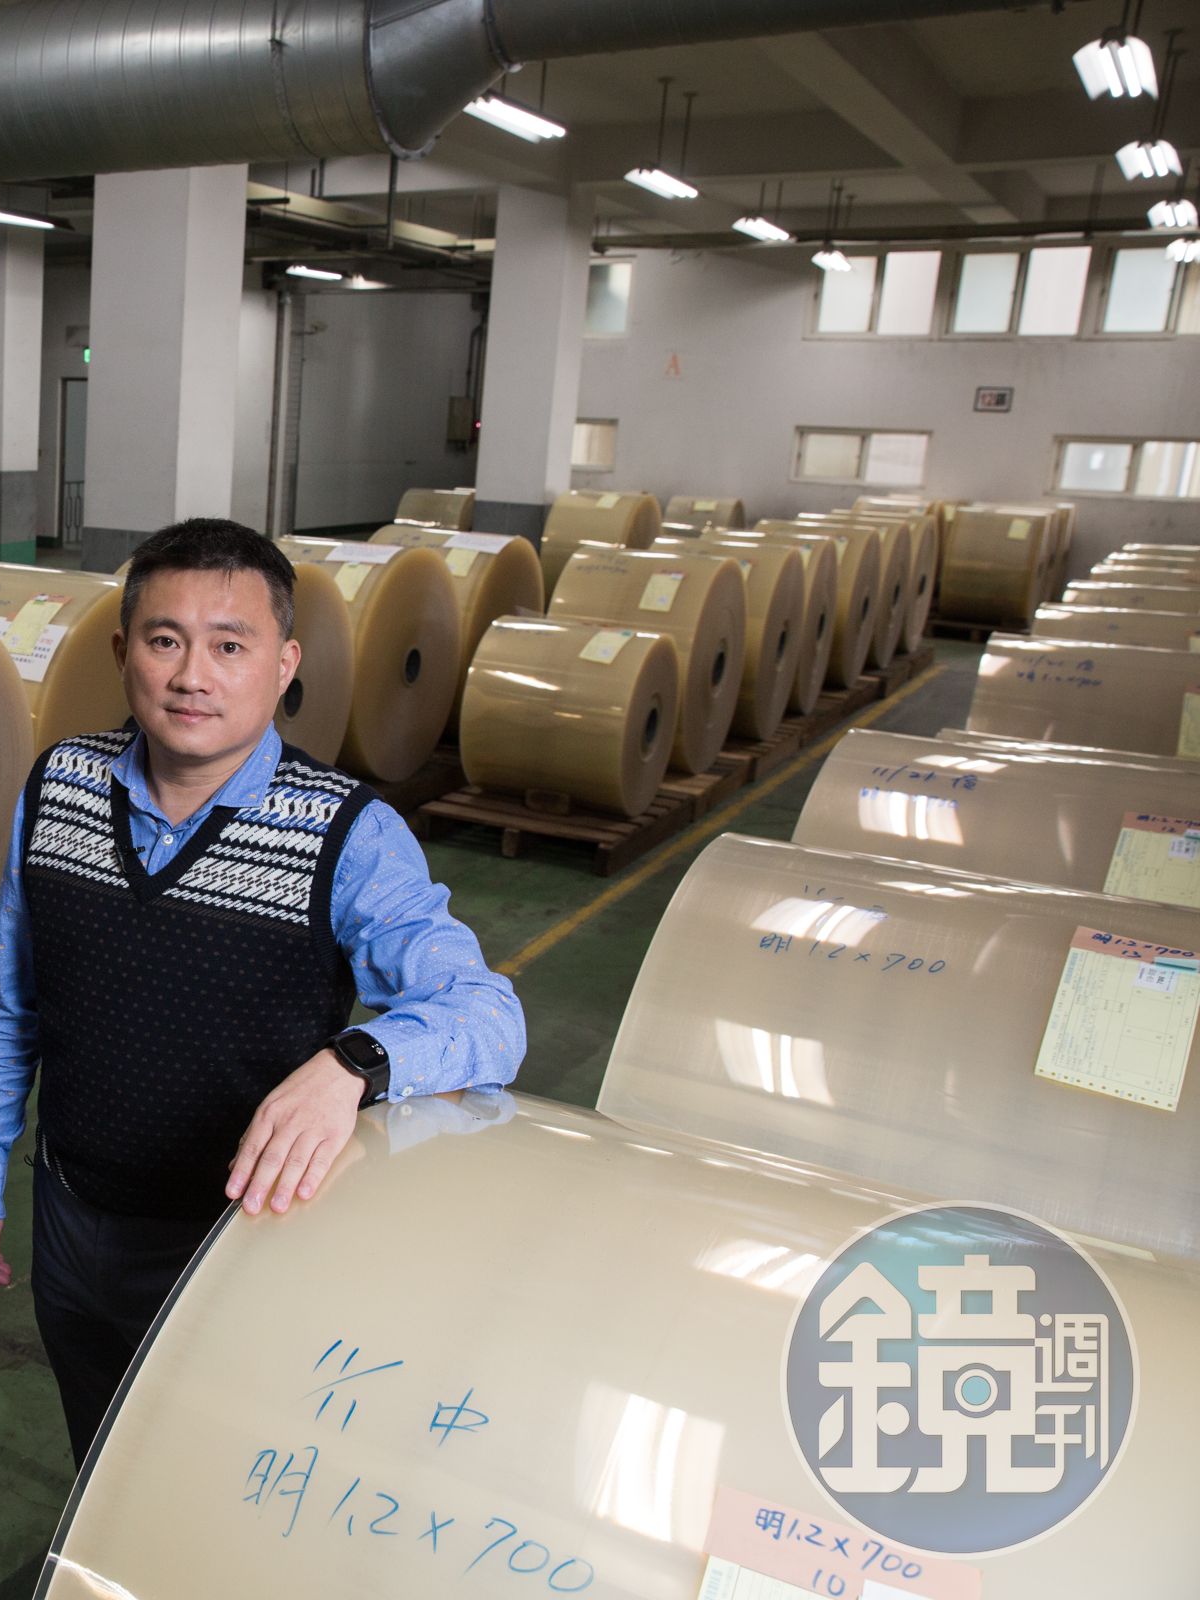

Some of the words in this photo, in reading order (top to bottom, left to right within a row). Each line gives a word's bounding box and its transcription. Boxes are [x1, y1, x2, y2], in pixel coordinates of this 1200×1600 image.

[881, 953, 946, 973] 700
[463, 1517, 594, 1592] 700
[861, 1539, 922, 1579] 700
[811, 1568, 846, 1597] 10
